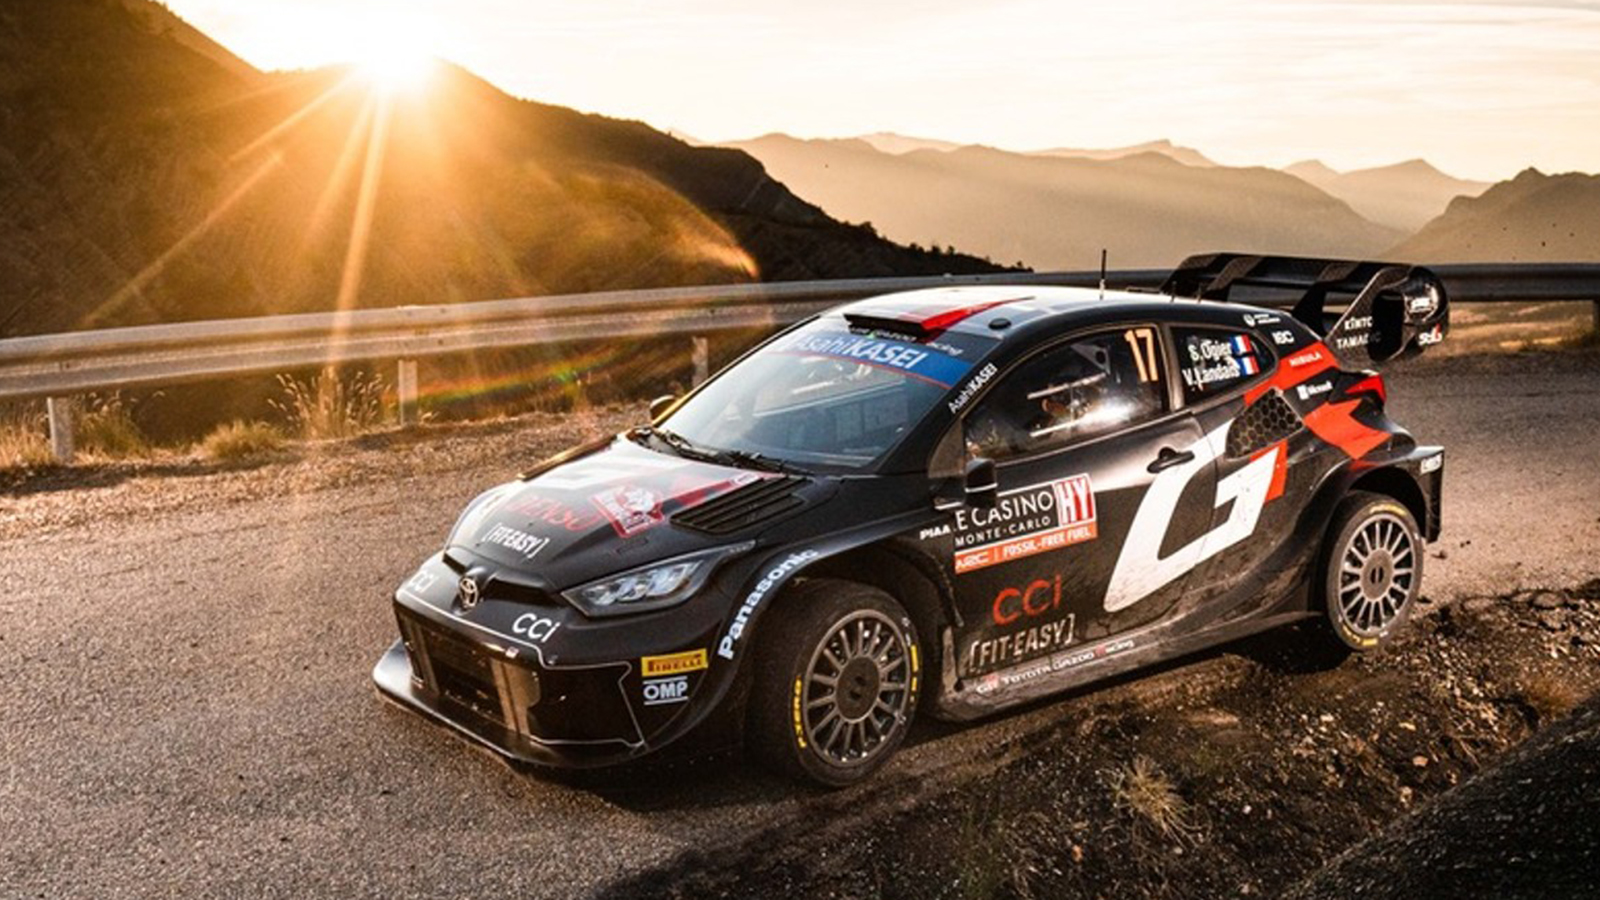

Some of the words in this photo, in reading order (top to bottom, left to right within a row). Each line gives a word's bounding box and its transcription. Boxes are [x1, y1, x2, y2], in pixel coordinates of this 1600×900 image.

[1124, 329, 1158, 382] 17
[948, 362, 998, 414] AsahiKASEI
[971, 490, 1054, 527] CASINO
[1054, 478, 1093, 524] HY
[718, 549, 819, 659] Panasonic
[647, 653, 702, 673] PIRELLI
[643, 680, 688, 700] OMP
